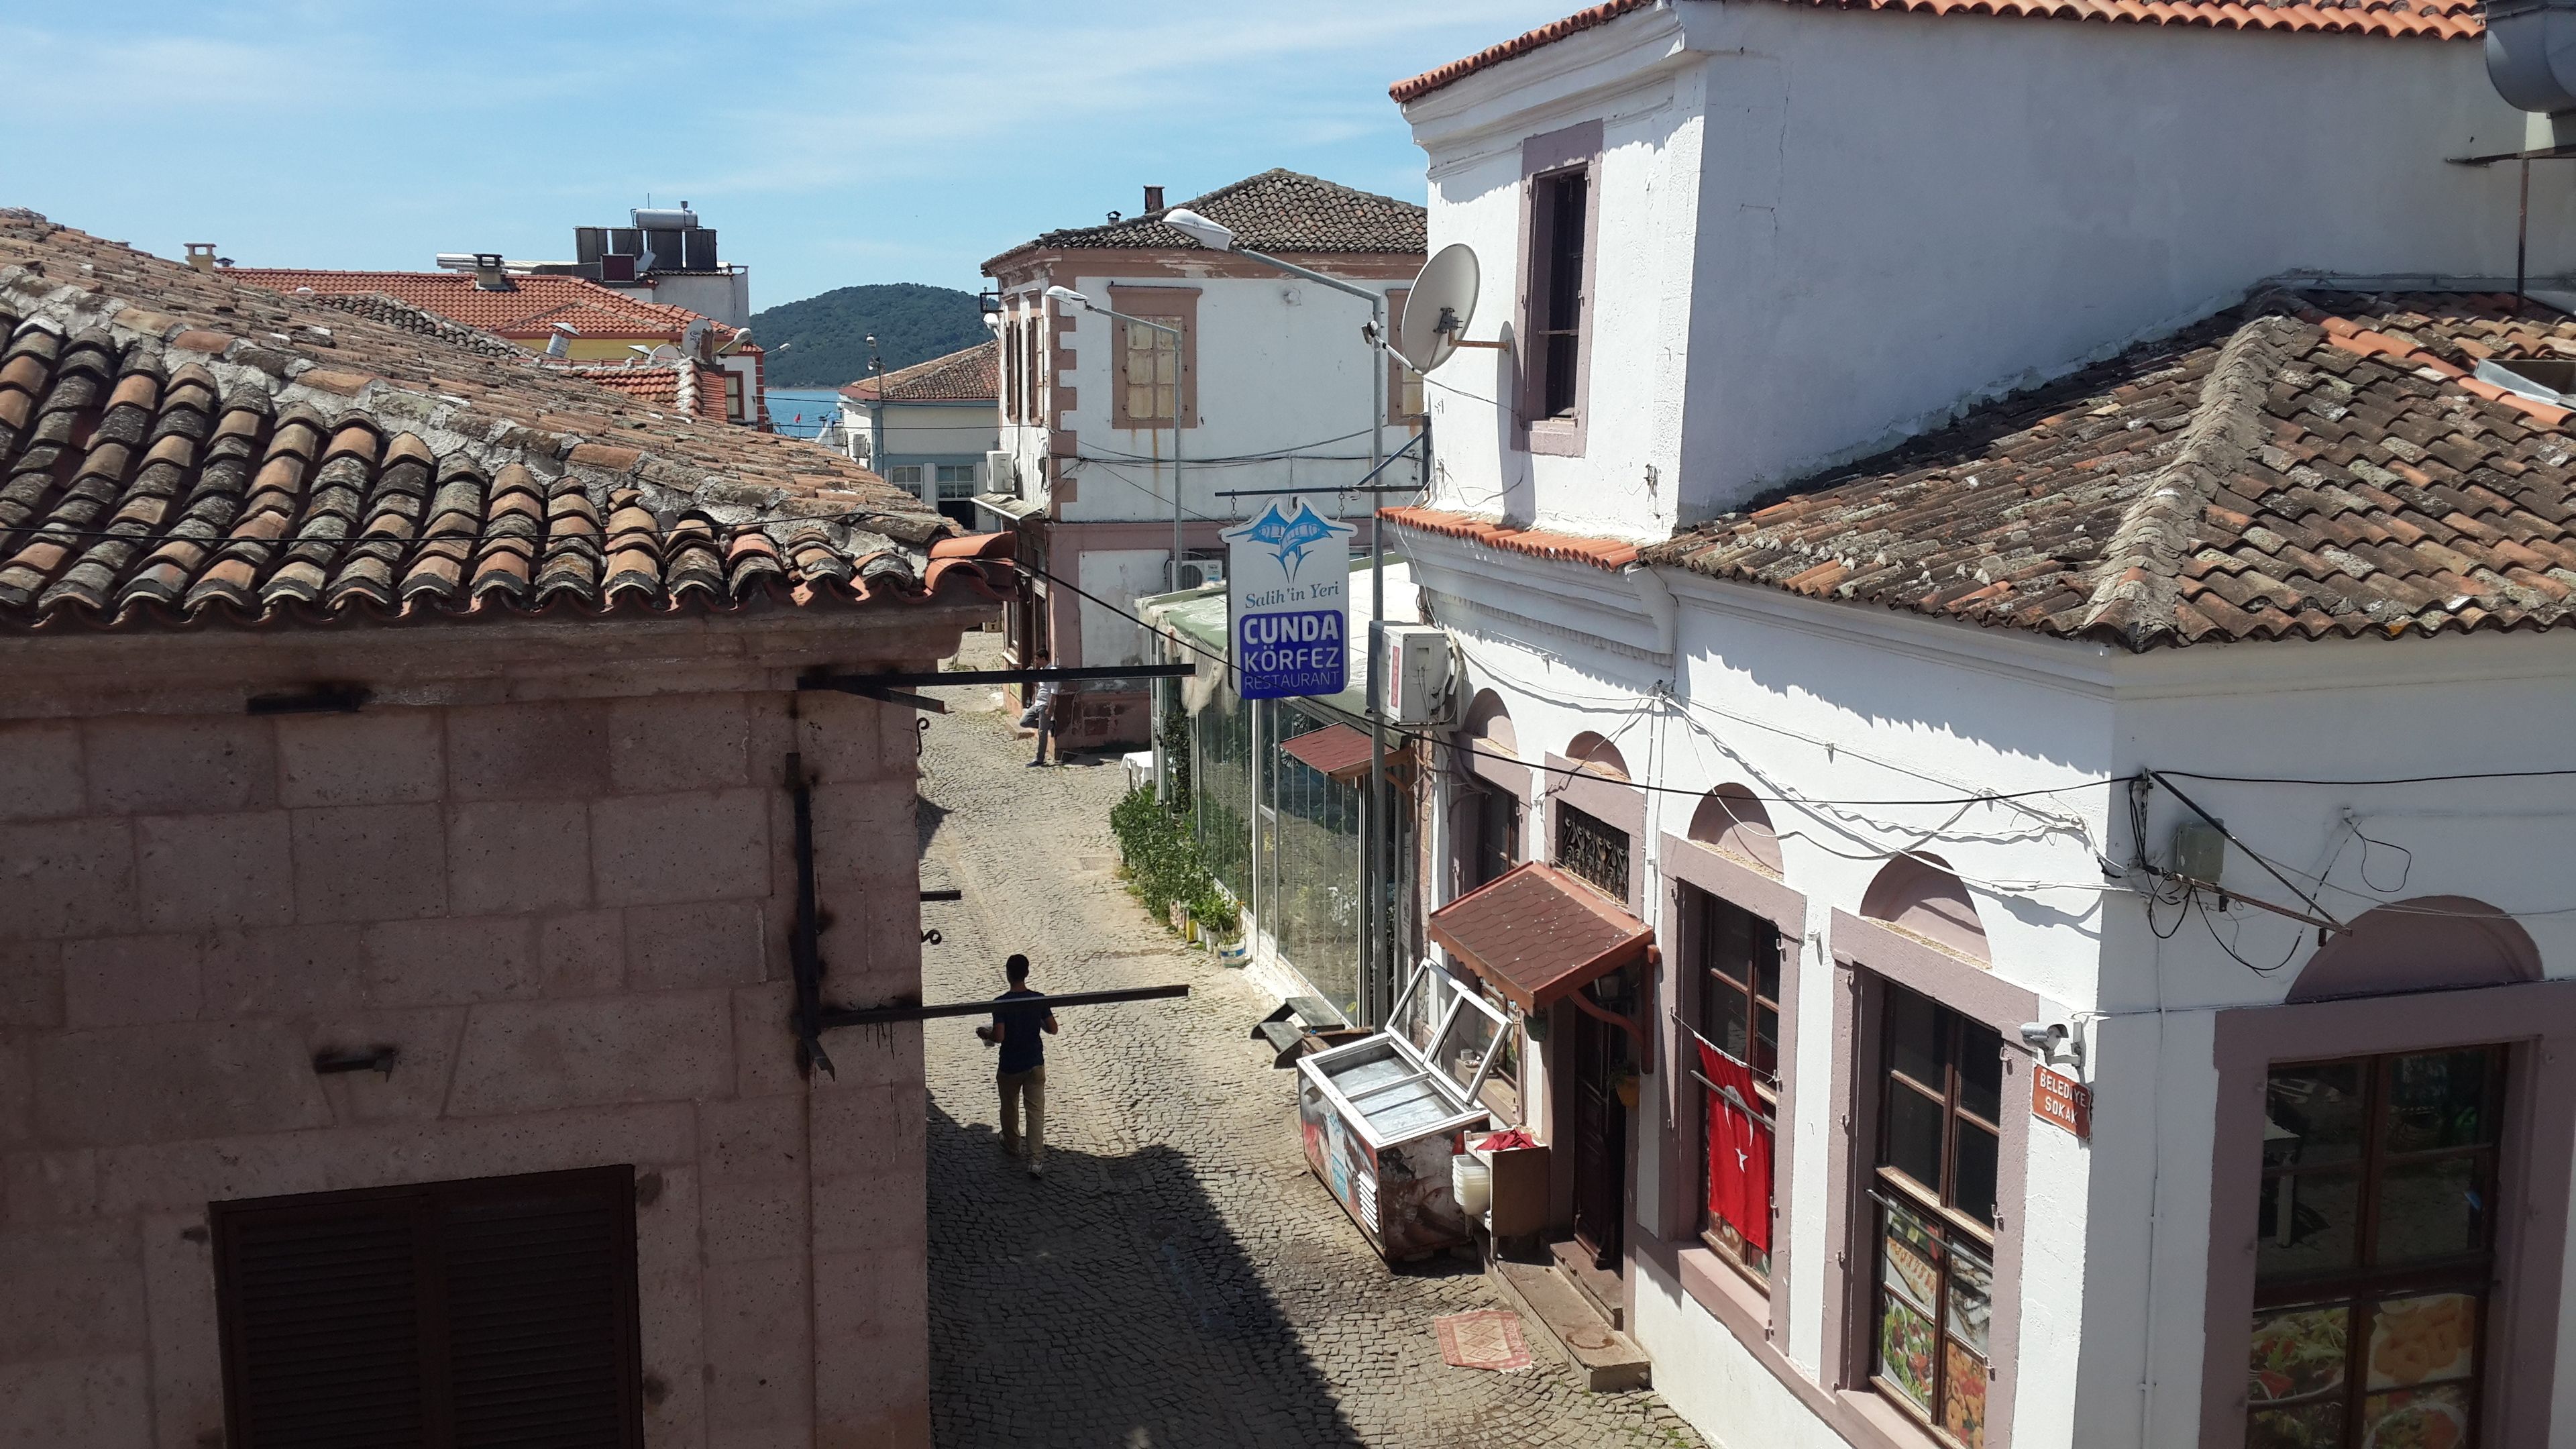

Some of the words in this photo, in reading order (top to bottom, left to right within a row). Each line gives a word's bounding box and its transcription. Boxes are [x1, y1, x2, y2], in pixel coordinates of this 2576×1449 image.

[1245, 588, 1305, 608] Salih'in
[1310, 581, 1340, 599] Yeri
[1244, 614, 1338, 644] CUNDA
[1244, 644, 1340, 674] KÖRFEZ
[1244, 671, 1340, 690] RESTAURANT
[2045, 1095, 2077, 1124] SOKAK
